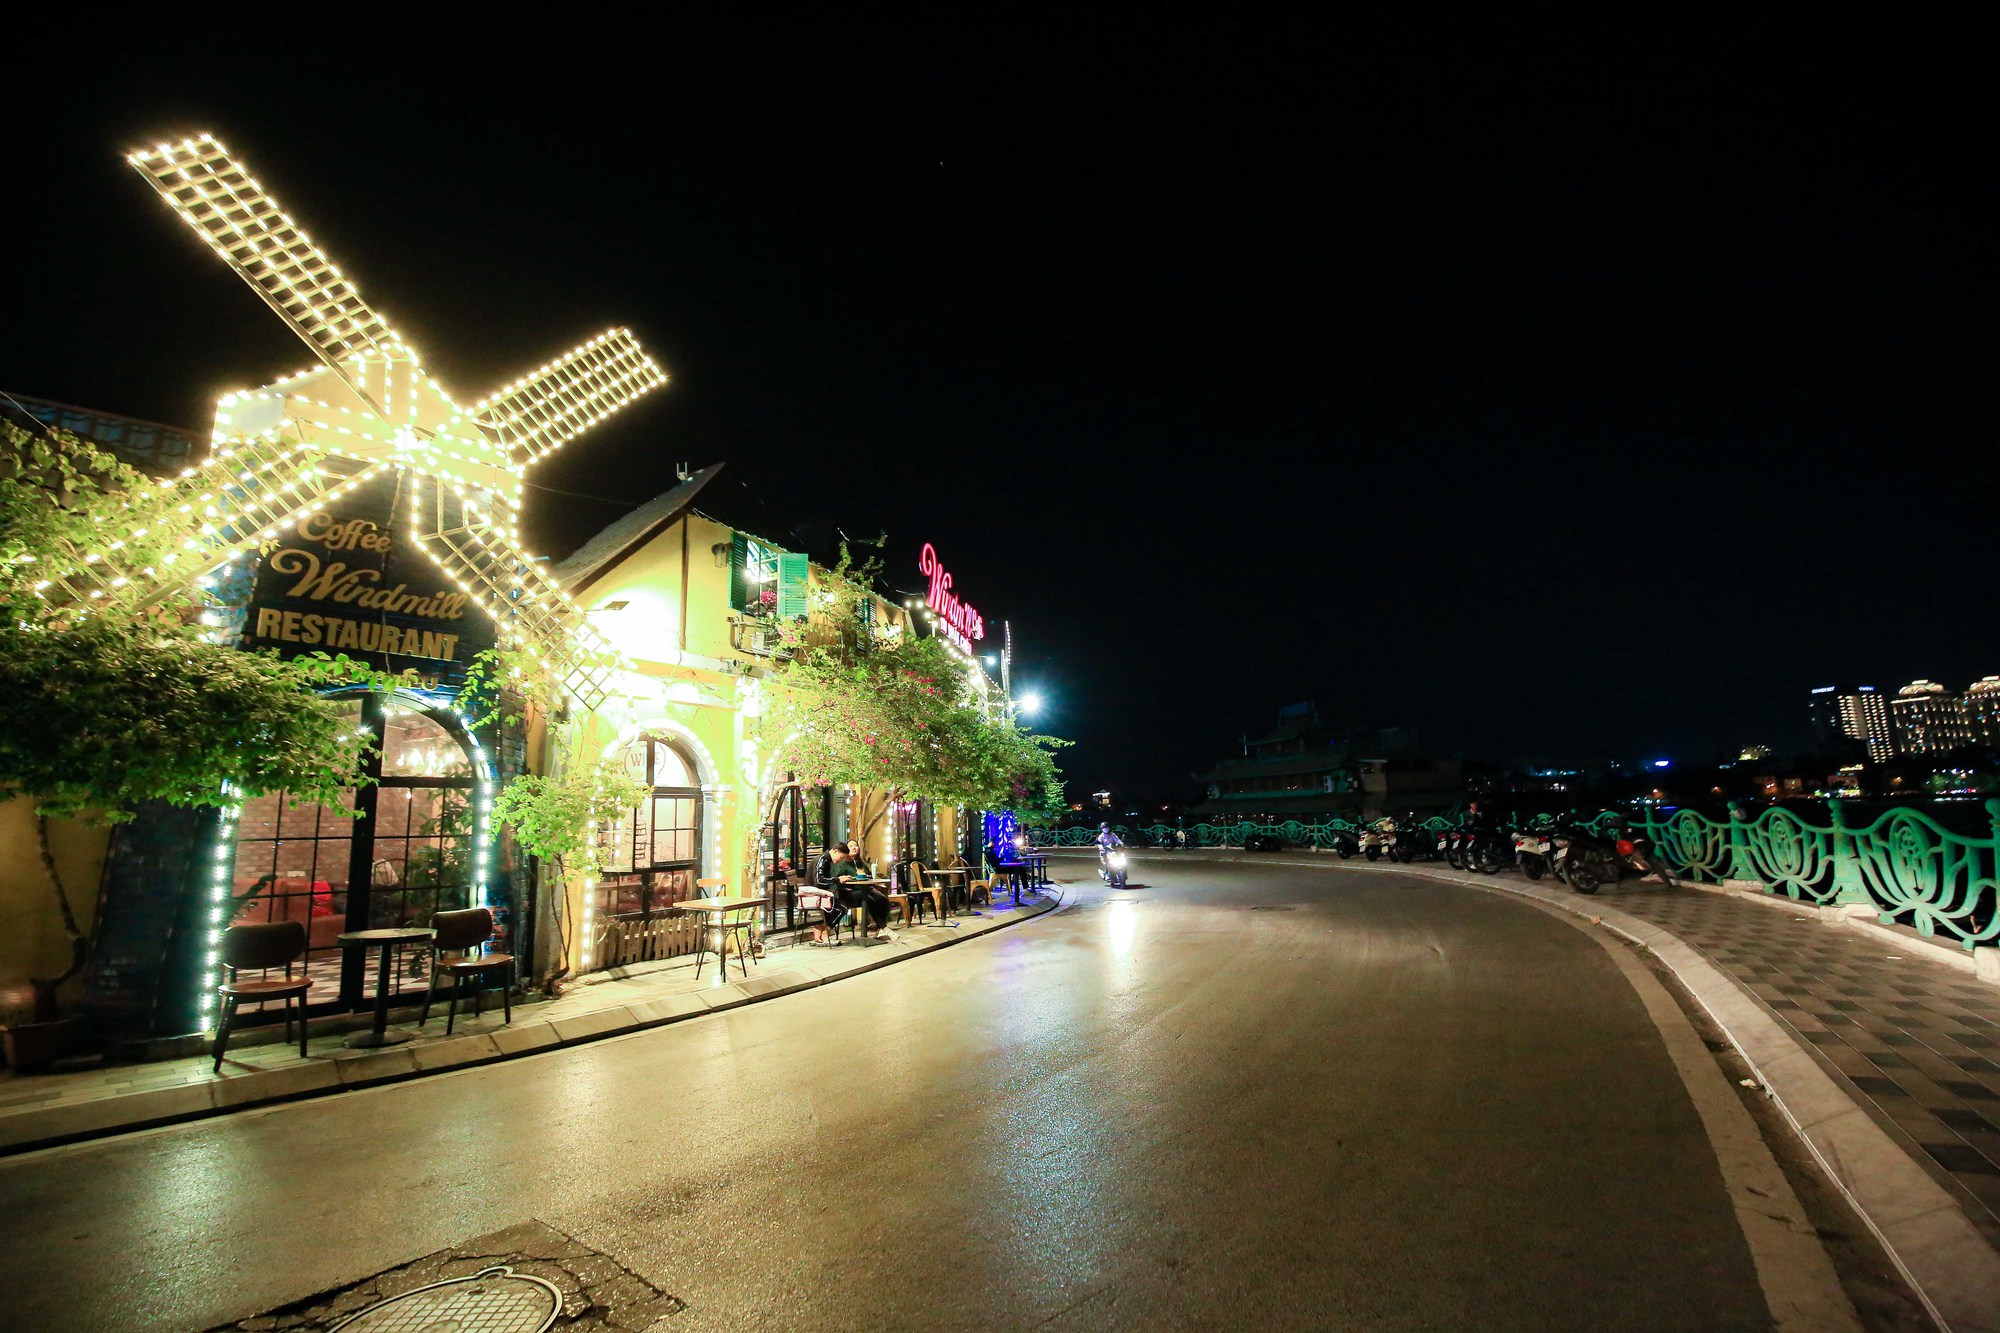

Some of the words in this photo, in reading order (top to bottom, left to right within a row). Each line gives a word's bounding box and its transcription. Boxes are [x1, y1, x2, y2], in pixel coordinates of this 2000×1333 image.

[298, 512, 392, 551] Coffee
[270, 549, 468, 620] Windmill
[256, 607, 459, 661] RESTAURANT
[630, 752, 660, 767] WIE
